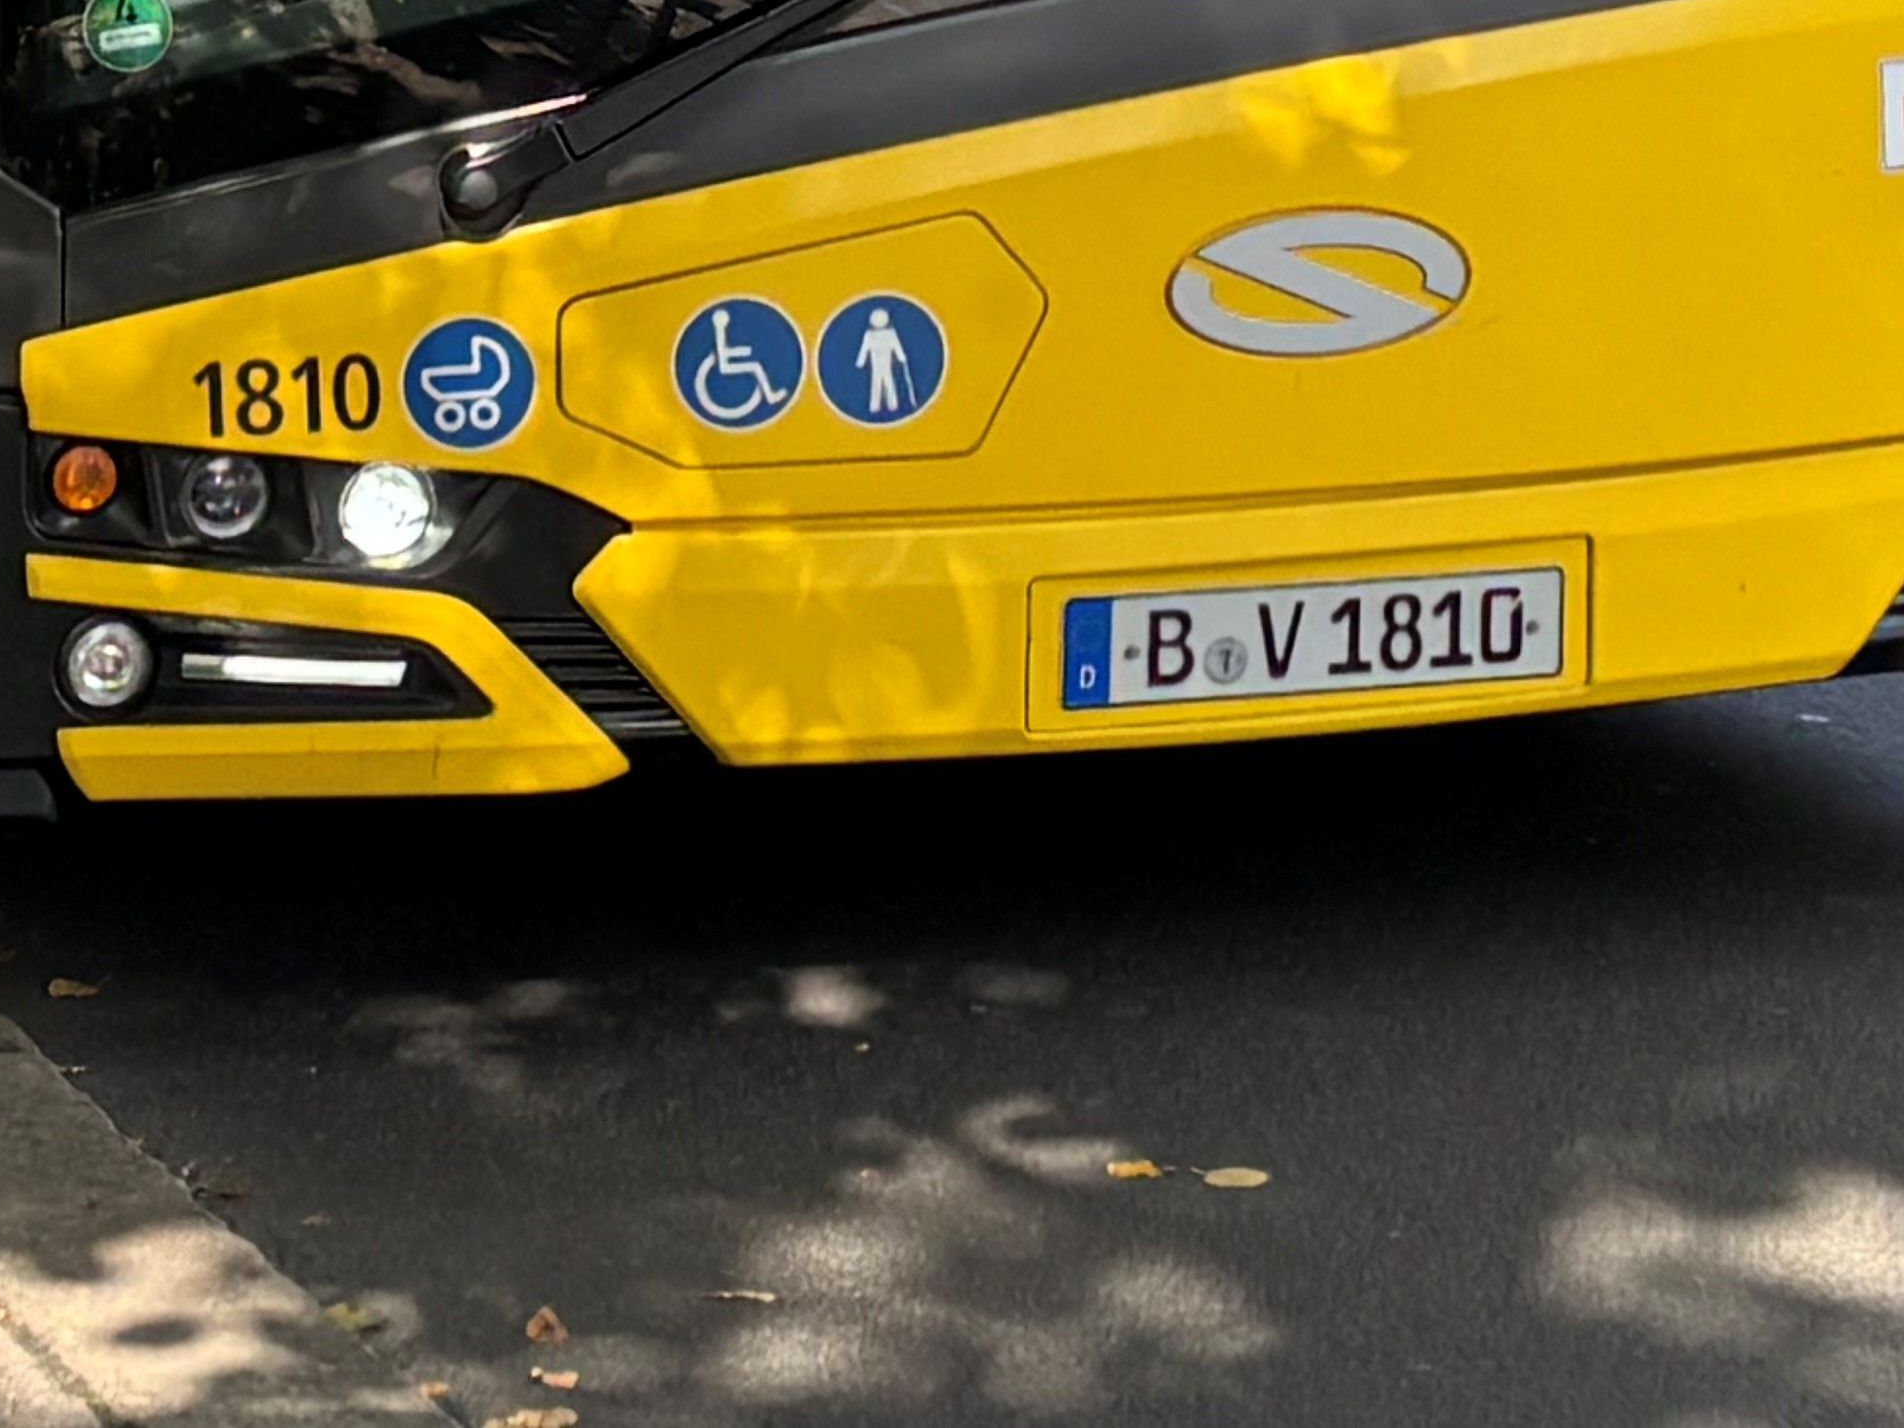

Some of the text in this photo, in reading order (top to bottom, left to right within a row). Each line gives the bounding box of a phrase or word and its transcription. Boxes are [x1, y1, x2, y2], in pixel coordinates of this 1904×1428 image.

[193, 353, 382, 439] 1810
[1079, 666, 1096, 690] D
[1147, 587, 1524, 688] B V 1810
